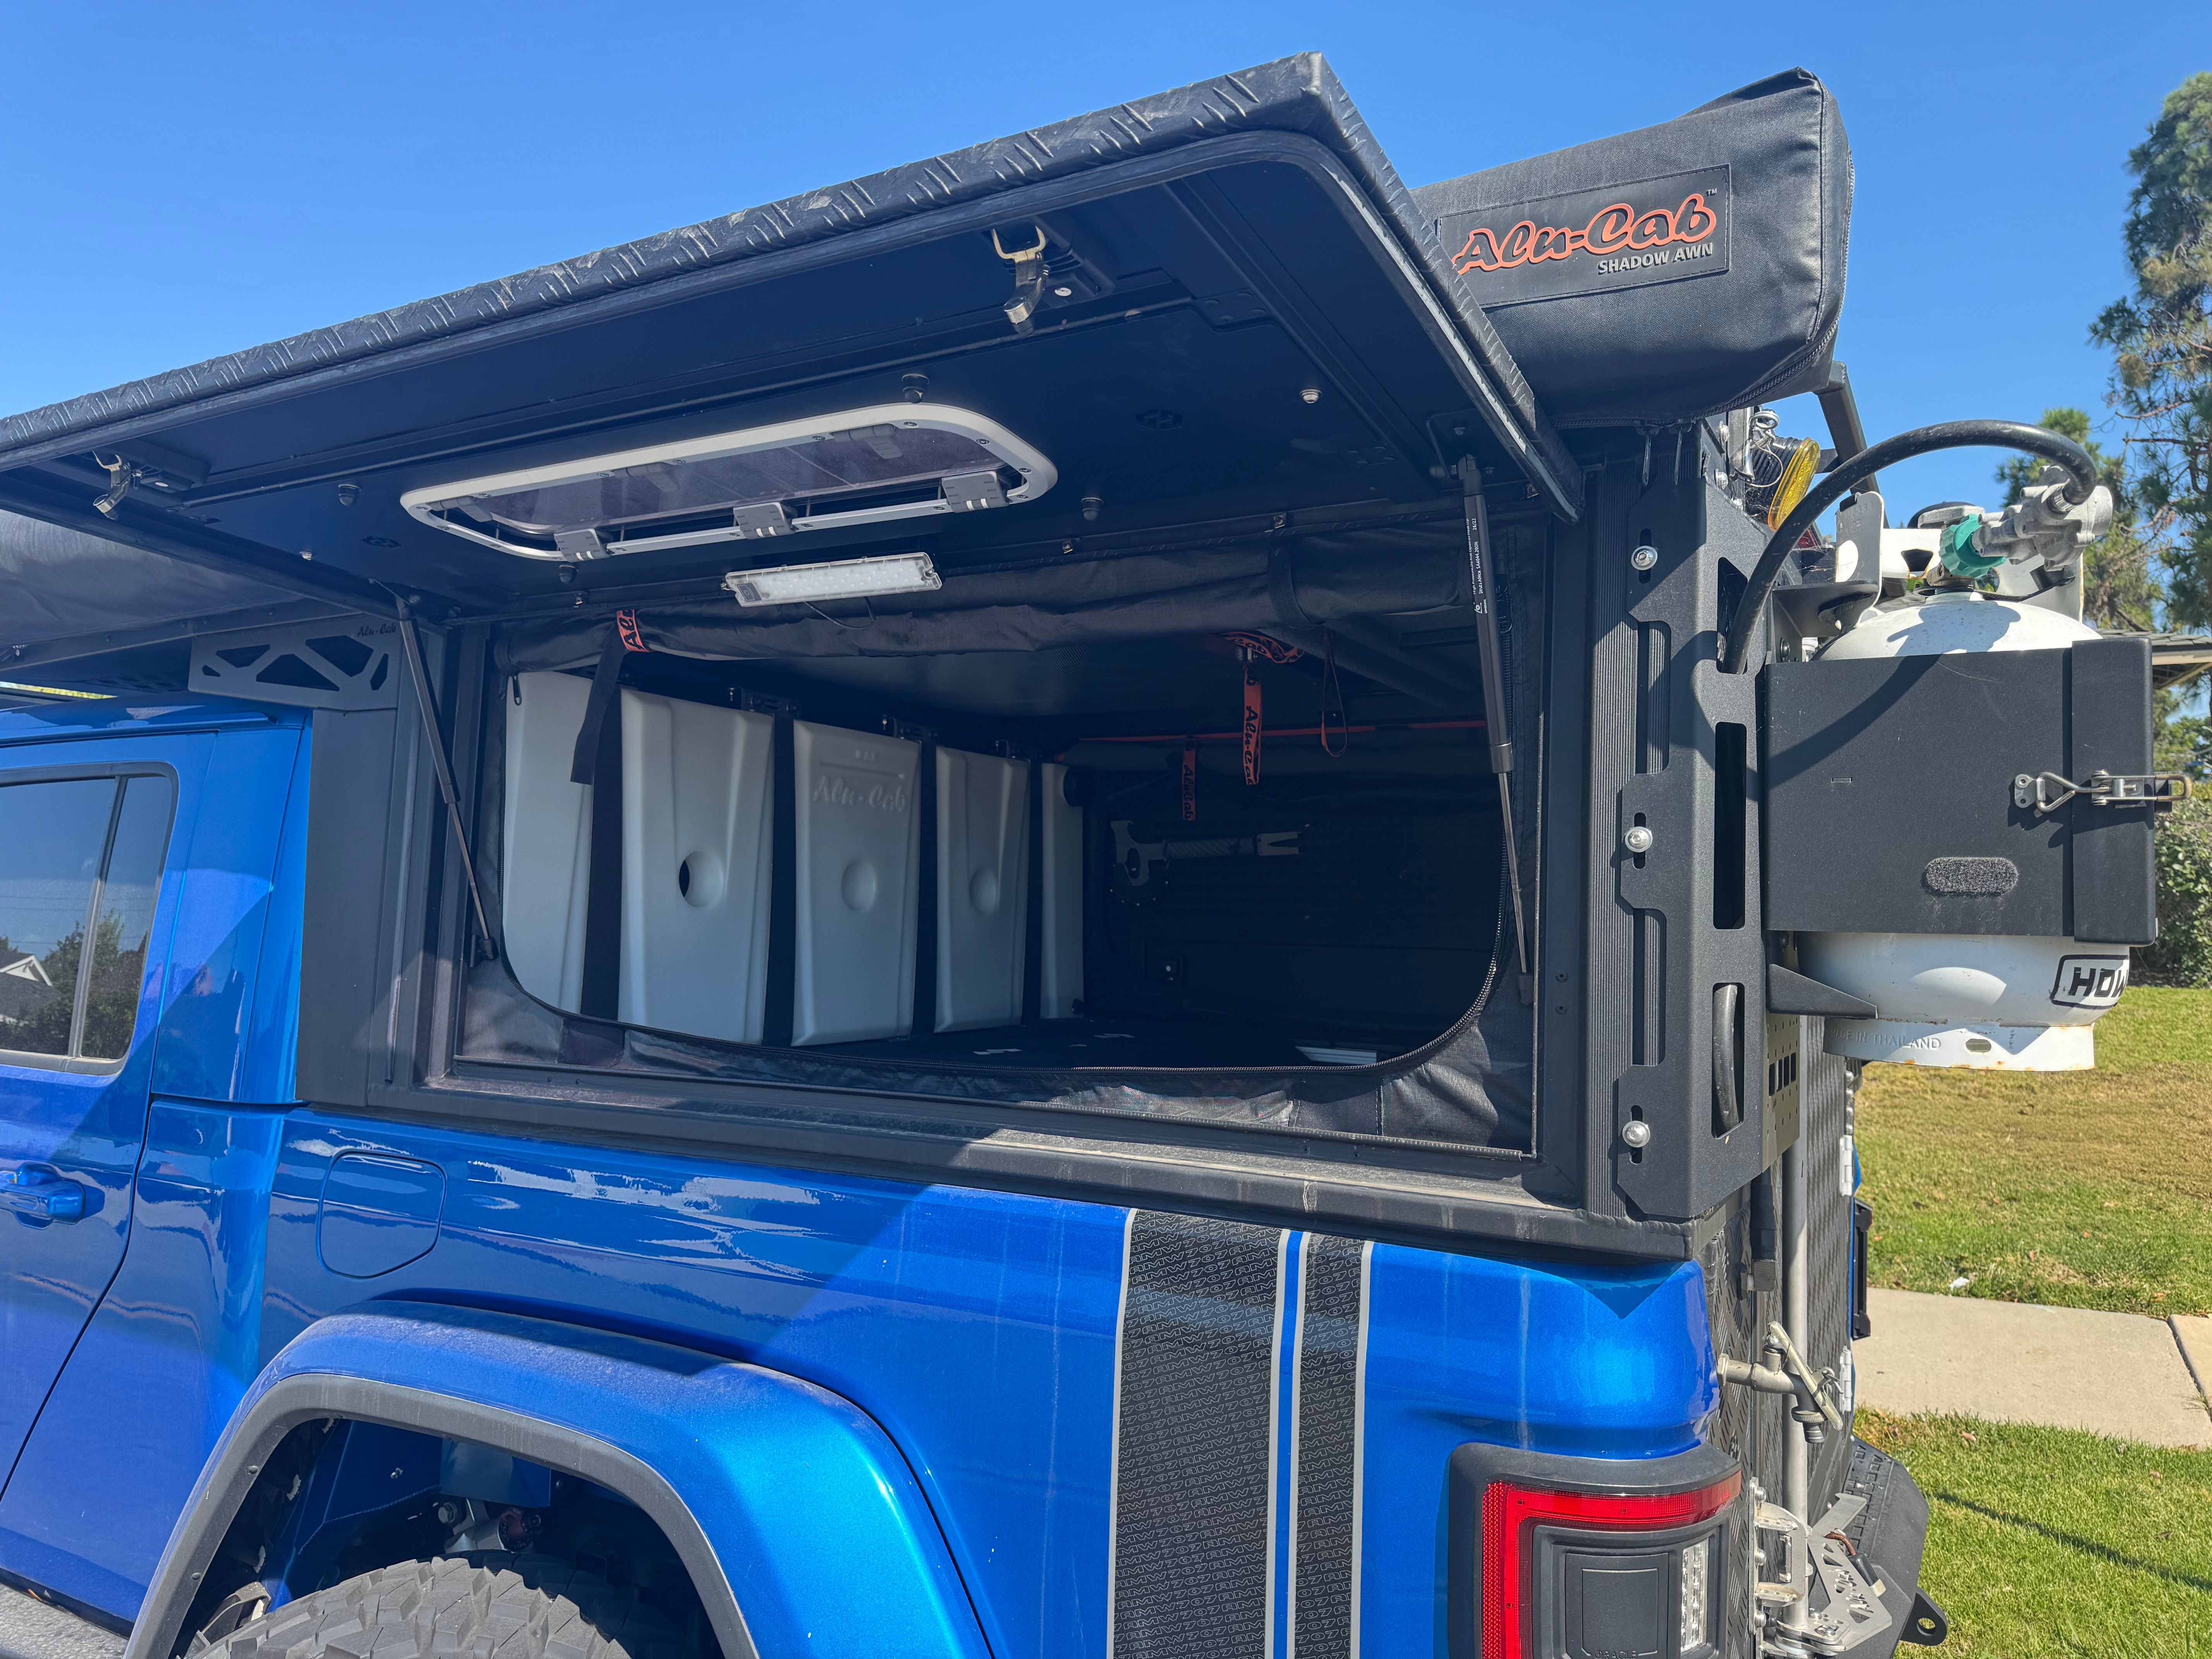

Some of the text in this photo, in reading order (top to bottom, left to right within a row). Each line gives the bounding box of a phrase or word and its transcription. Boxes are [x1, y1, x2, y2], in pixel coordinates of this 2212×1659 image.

[1451, 193, 1716, 275] Alu-Cab
[1598, 242, 1713, 275] SHADOW AWN
[1856, 1030, 1868, 1042] IN
[1871, 1033, 1942, 1051] THAILAND
